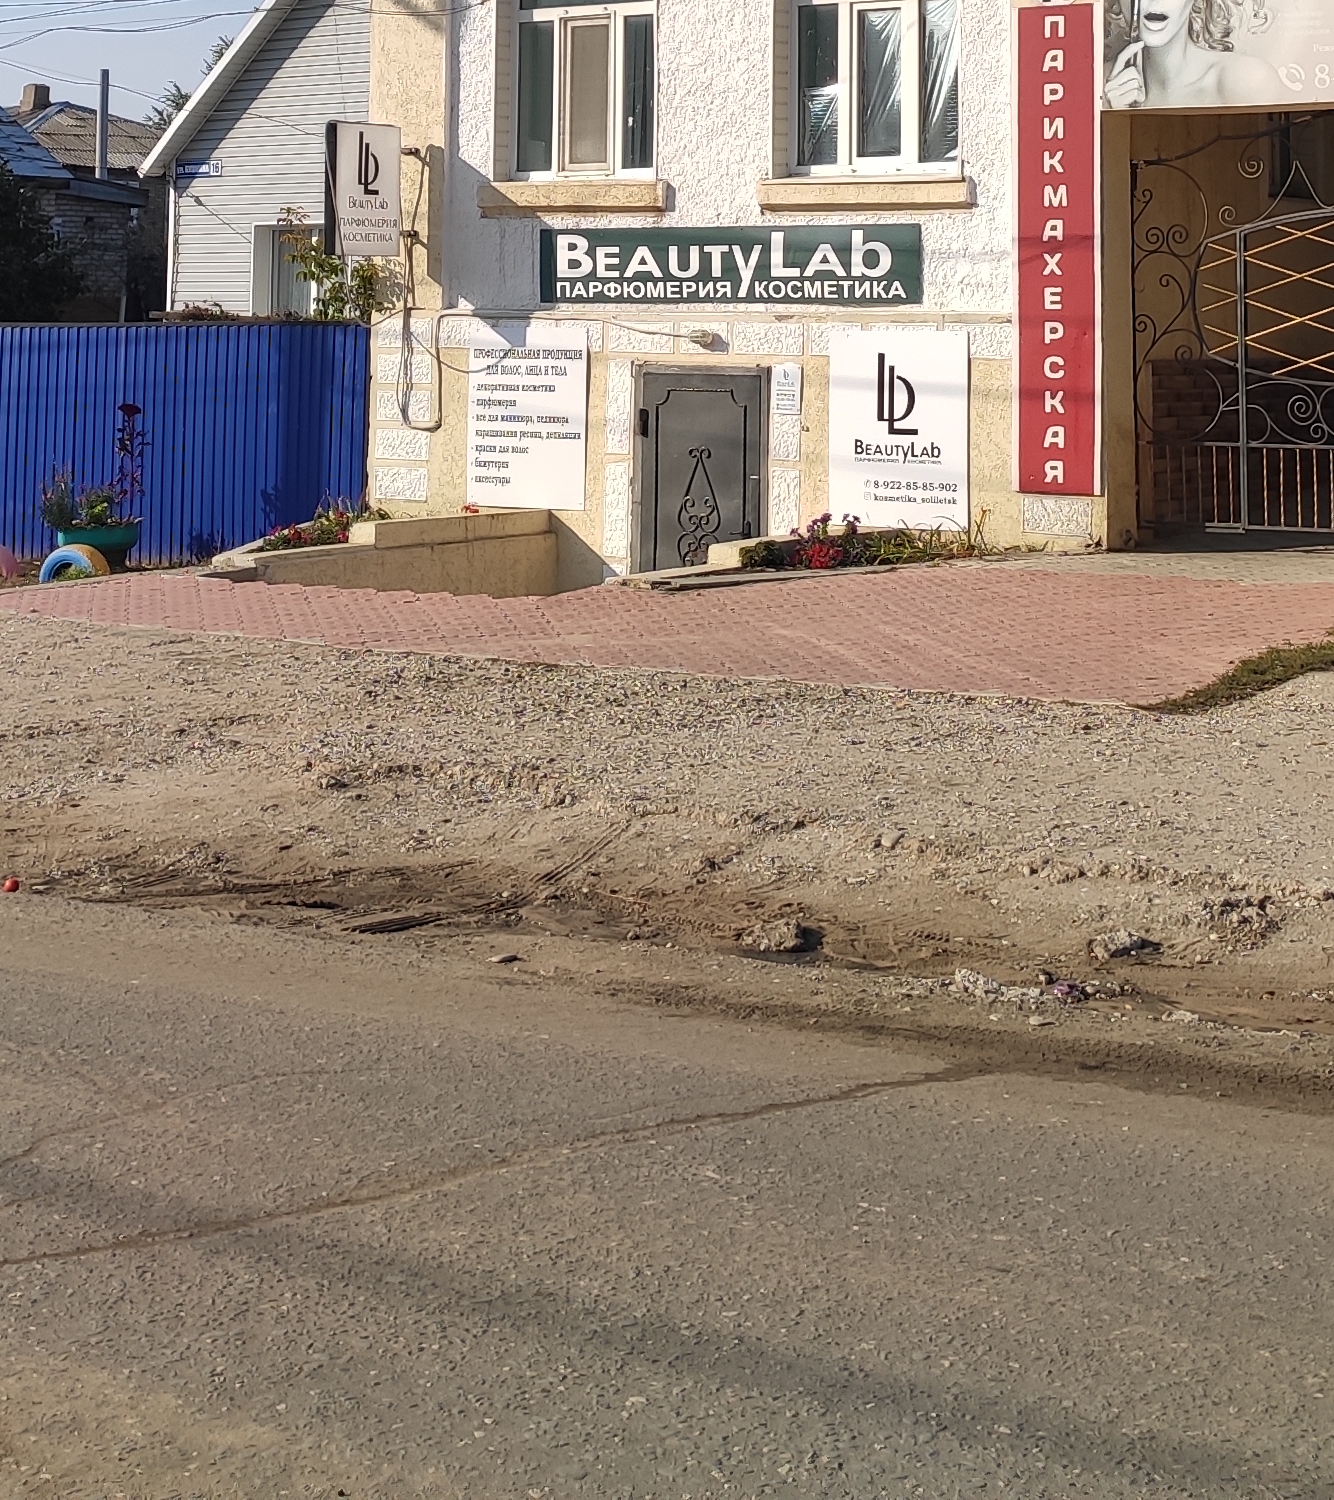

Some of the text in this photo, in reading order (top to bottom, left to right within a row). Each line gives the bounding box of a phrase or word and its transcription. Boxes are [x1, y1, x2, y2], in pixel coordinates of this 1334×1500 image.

[339, 216, 398, 230] ПАРФЮМЕРИЯ
[343, 231, 394, 243] КОСМЕТИКА
[1042, 14, 1068, 485] ПАРИКМАХЕРСКАЯ
[555, 279, 907, 299] ПАРФЮМЕРИЯ КОСМЕТИКА
[473, 348, 583, 361] ПРОФЕССИОНАЛЬНАЯ ПРОДУКЦИЯ
[525, 365, 543, 376] ЛИЦА
[551, 366, 567, 376] ТЕЛА
[521, 384, 556, 393] косметика
[511, 446, 530, 454] волос
[873, 479, 958, 492] 8-922-85-85-902
